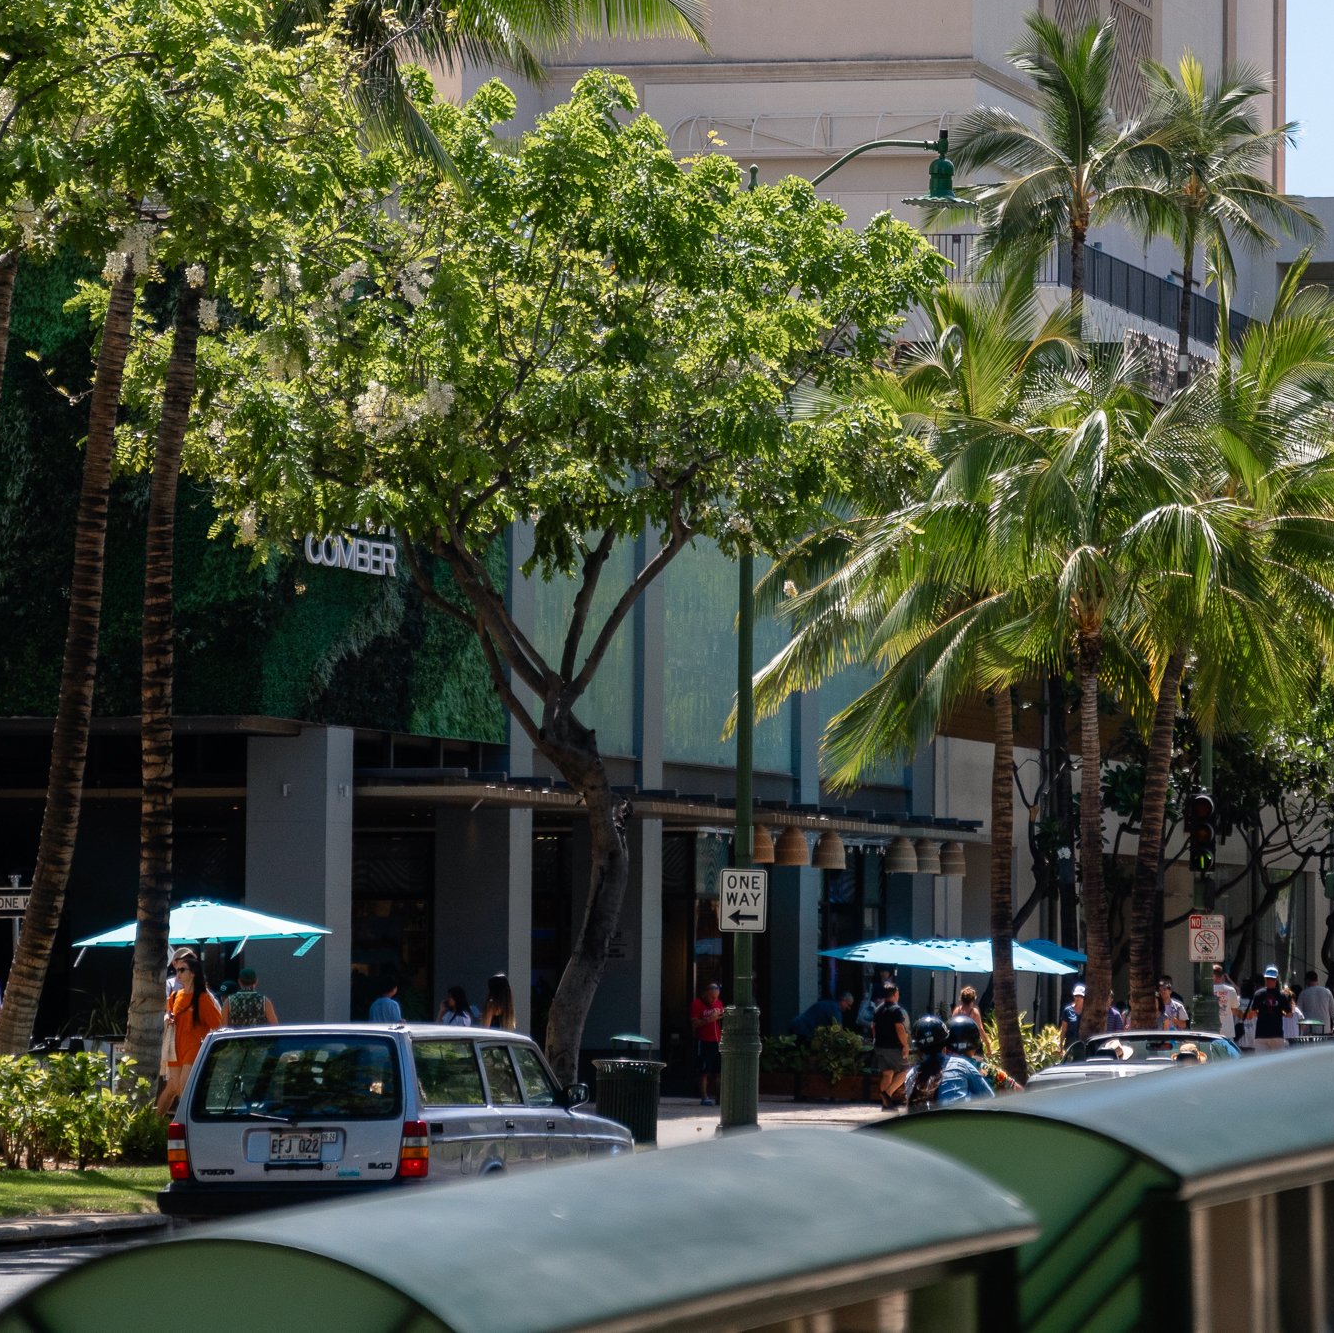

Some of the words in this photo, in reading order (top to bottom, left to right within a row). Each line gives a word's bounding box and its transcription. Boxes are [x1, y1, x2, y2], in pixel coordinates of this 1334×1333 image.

[305, 532, 397, 577] COMBER
[727, 875, 761, 890] ONE
[726, 892, 762, 907] WAY
[1191, 917, 1202, 928] NO
[271, 1139, 292, 1154] EFJ
[298, 1139, 319, 1154] 022
